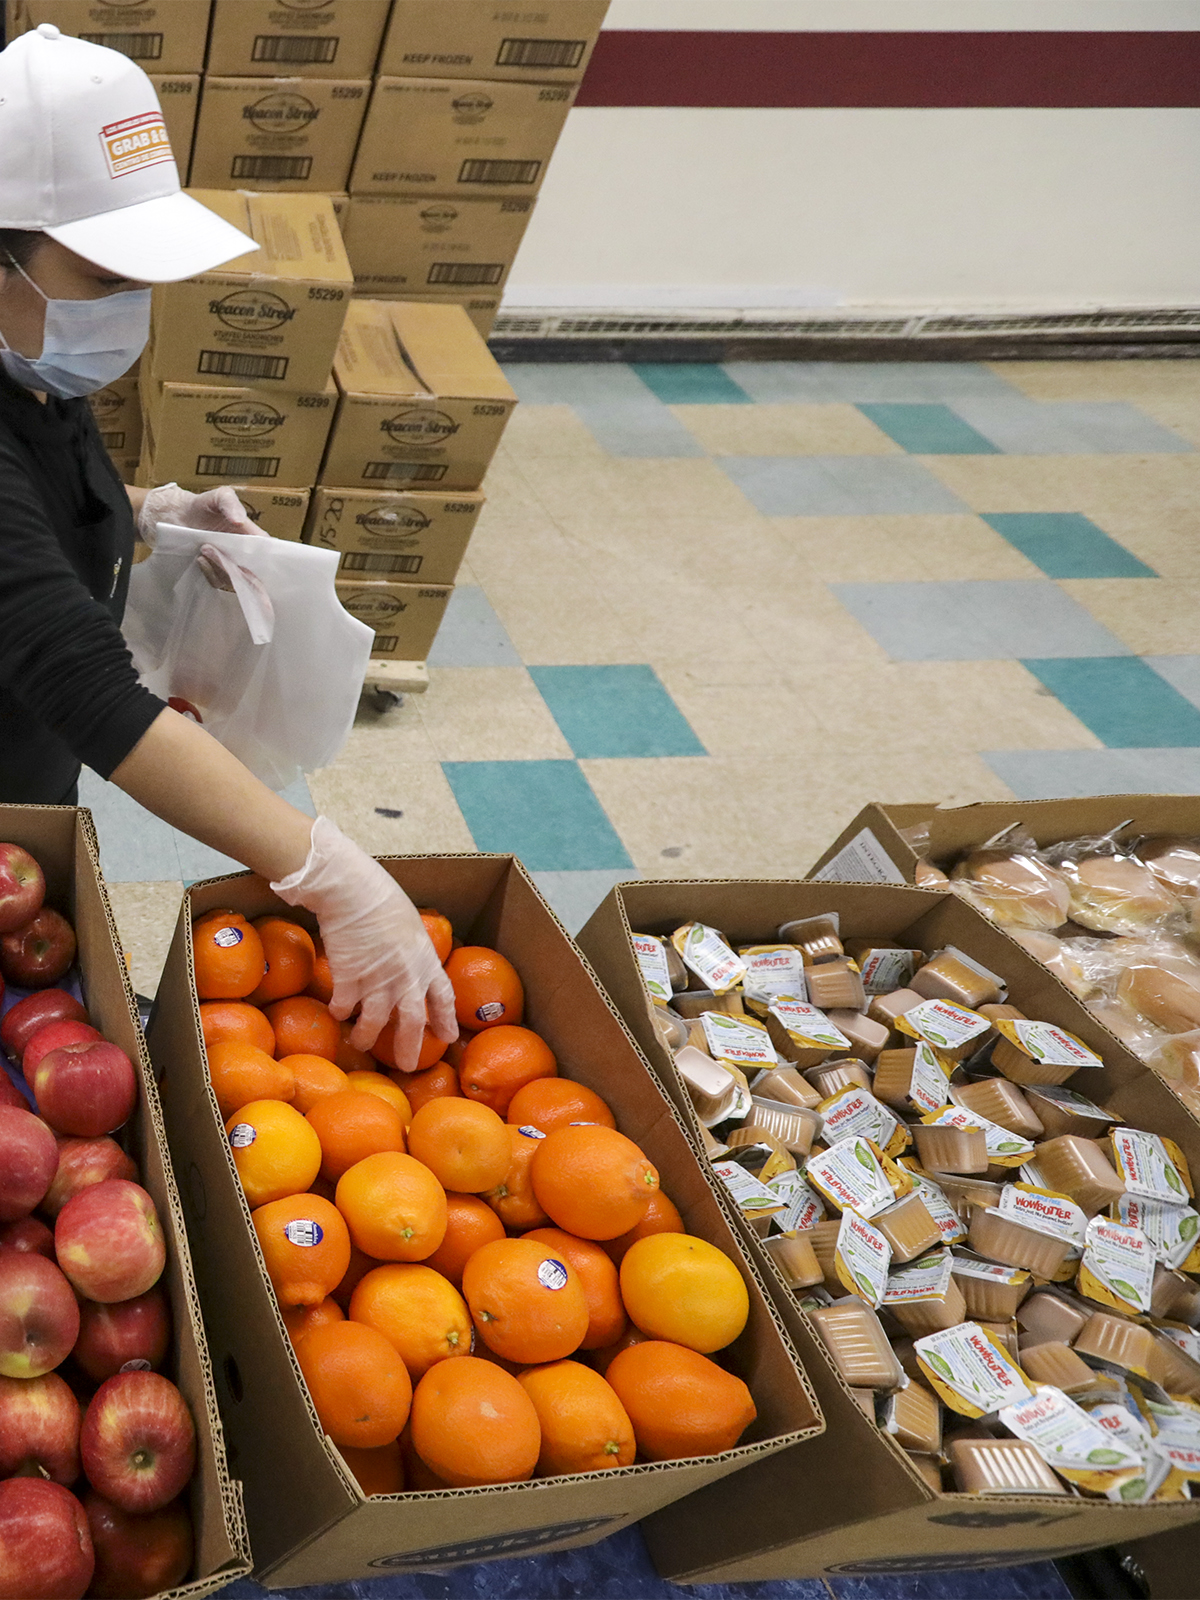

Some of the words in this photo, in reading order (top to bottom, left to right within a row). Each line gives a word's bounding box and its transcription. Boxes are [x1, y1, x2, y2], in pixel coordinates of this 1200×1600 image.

[402, 53, 431, 64] KEEP
[432, 55, 473, 66] FROZEN
[161, 82, 192, 94] 55299
[331, 87, 363, 99] 55299
[242, 105, 283, 119] Beacon
[111, 132, 151, 156] GRAB
[150, 130, 159, 144] &
[373, 172, 399, 182] KEEP
[400, 173, 437, 183] FROZEN
[308, 287, 344, 301] 55299
[209, 300, 255, 316] Beacon
[257, 303, 296, 320] Street
[297, 396, 329, 408] 55299
[473, 405, 505, 416] 55299
[205, 411, 249, 426] Beacon
[250, 413, 286, 427] Street
[380, 419, 423, 434] Beacon
[425, 421, 461, 435] Street
[272, 495, 302, 507] 55299
[443, 502, 475, 514] 55299
[356, 514, 396, 527] Beacon
[398, 516, 433, 529] Street
[418, 589, 448, 599] 55299
[343, 602, 373, 611] eacon
[826, 1097, 864, 1126] WOWBUTTER
[1122, 1138, 1138, 1181] WOWBUTTER
[820, 1170, 861, 1208] WOWBUTTER
[1016, 1196, 1072, 1220] WOWBUTTER
[1128, 1201, 1138, 1230] BUTTER
[851, 1218, 885, 1252] WOWBUTTER
[1097, 1226, 1144, 1250] WOWBUTTER
[969, 1334, 1013, 1388] WOWBUTTER
